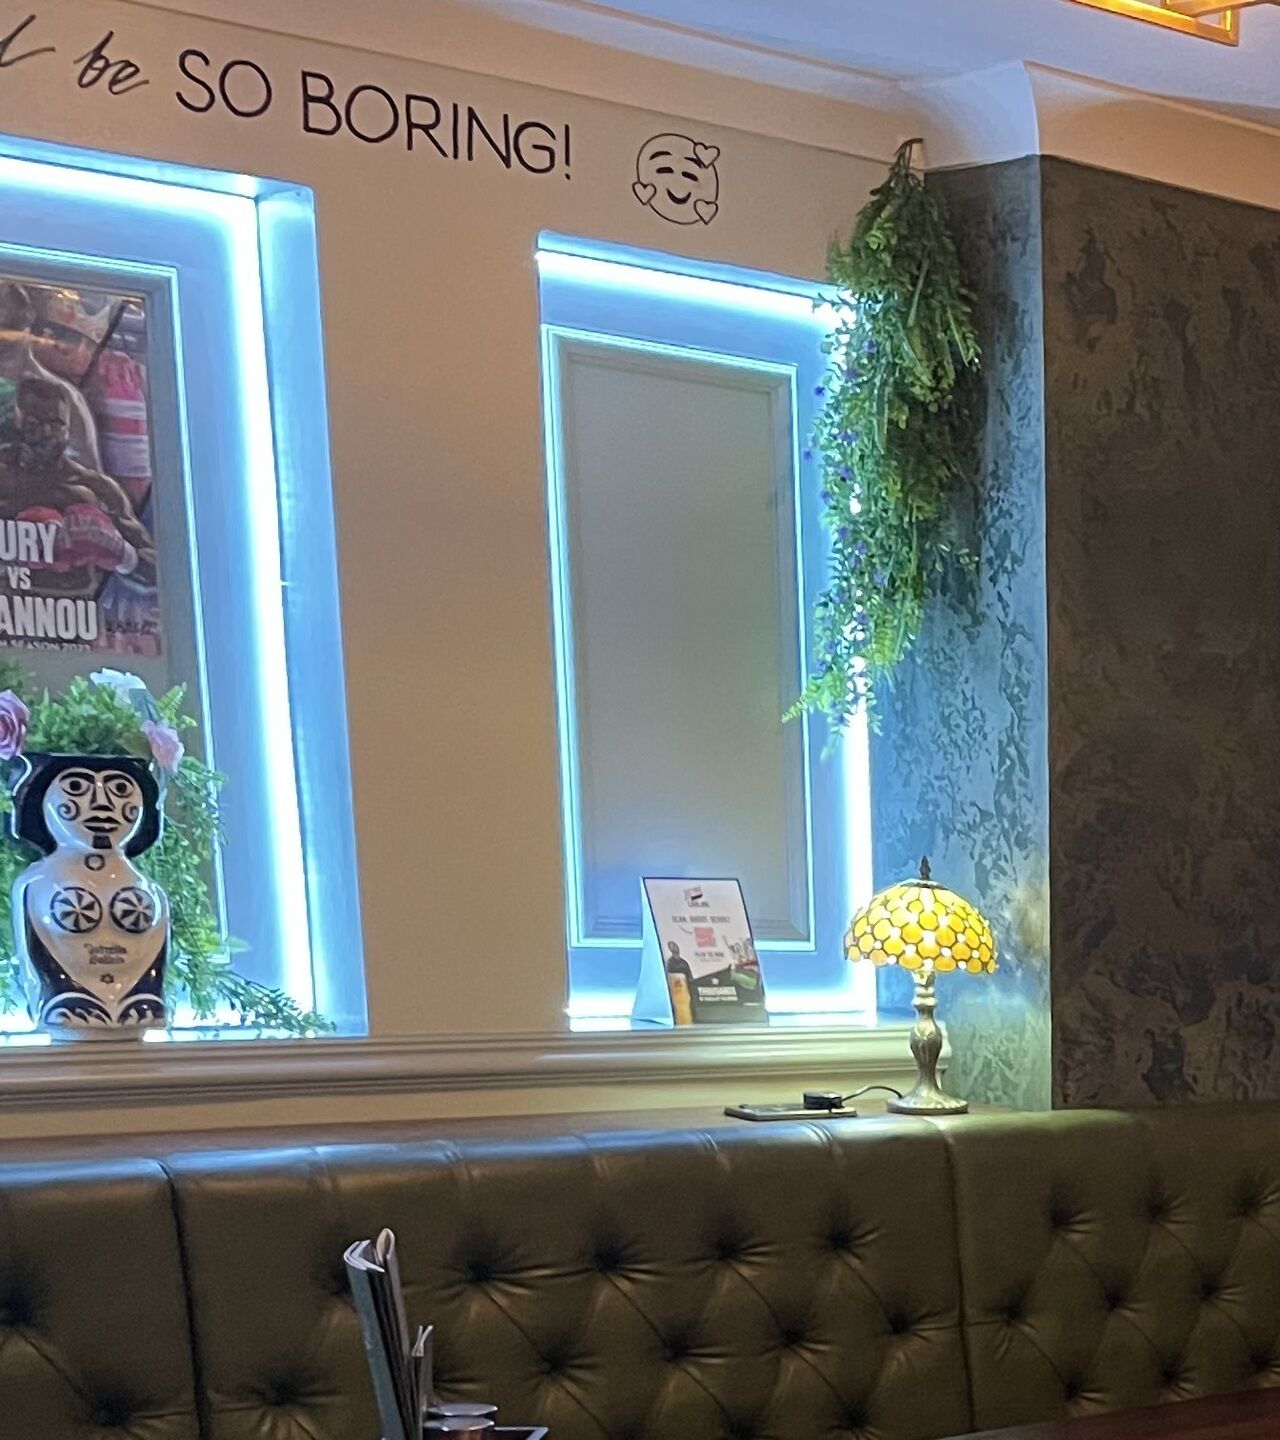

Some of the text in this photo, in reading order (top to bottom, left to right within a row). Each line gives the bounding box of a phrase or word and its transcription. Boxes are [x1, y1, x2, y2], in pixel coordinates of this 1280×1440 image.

[74, 30, 150, 95] be
[175, 49, 273, 118] SO
[301, 69, 573, 181] BORING!
